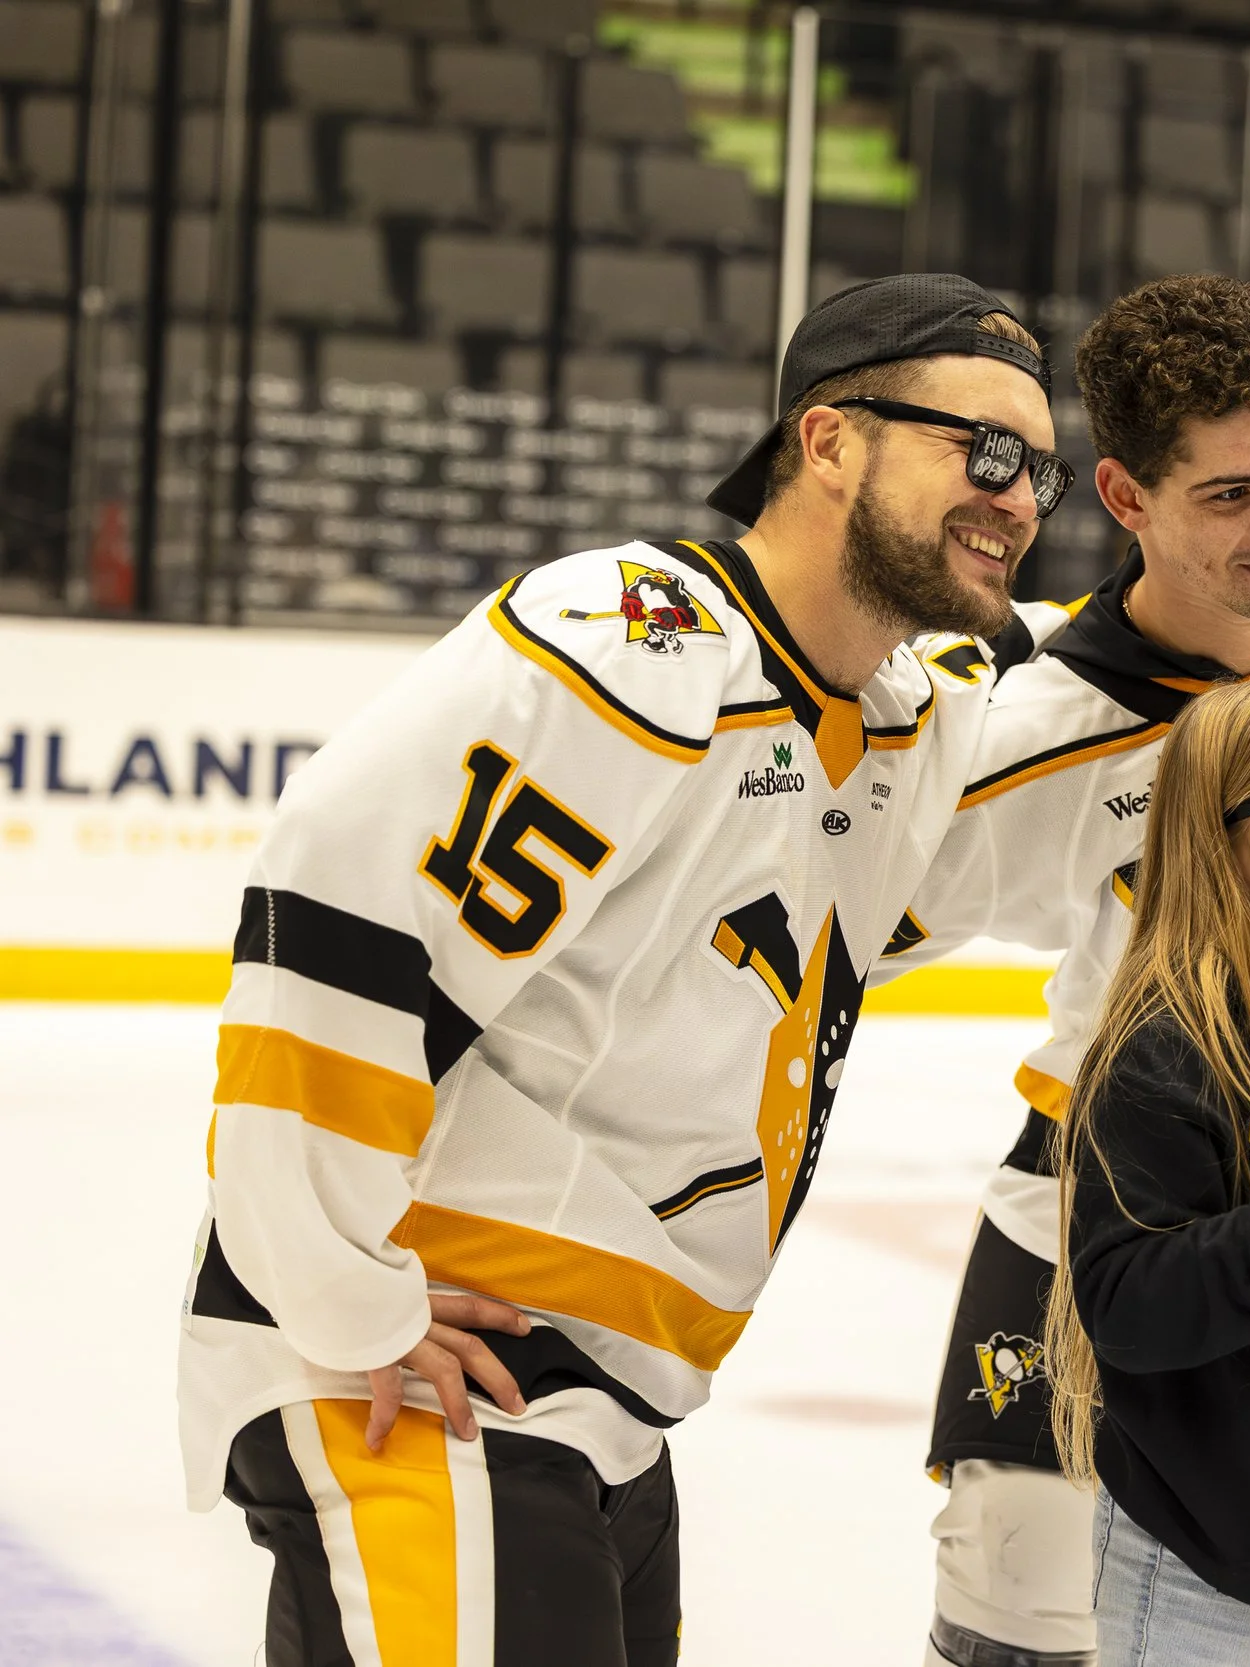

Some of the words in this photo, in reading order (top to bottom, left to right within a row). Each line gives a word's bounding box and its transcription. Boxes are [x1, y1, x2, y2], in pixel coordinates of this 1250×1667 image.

[983, 431, 1023, 463] HOME
[973, 456, 1016, 484] OPENER
[738, 766, 805, 799] WesBanco
[1102, 782, 1155, 821] Wes
[416, 739, 617, 960] 15
